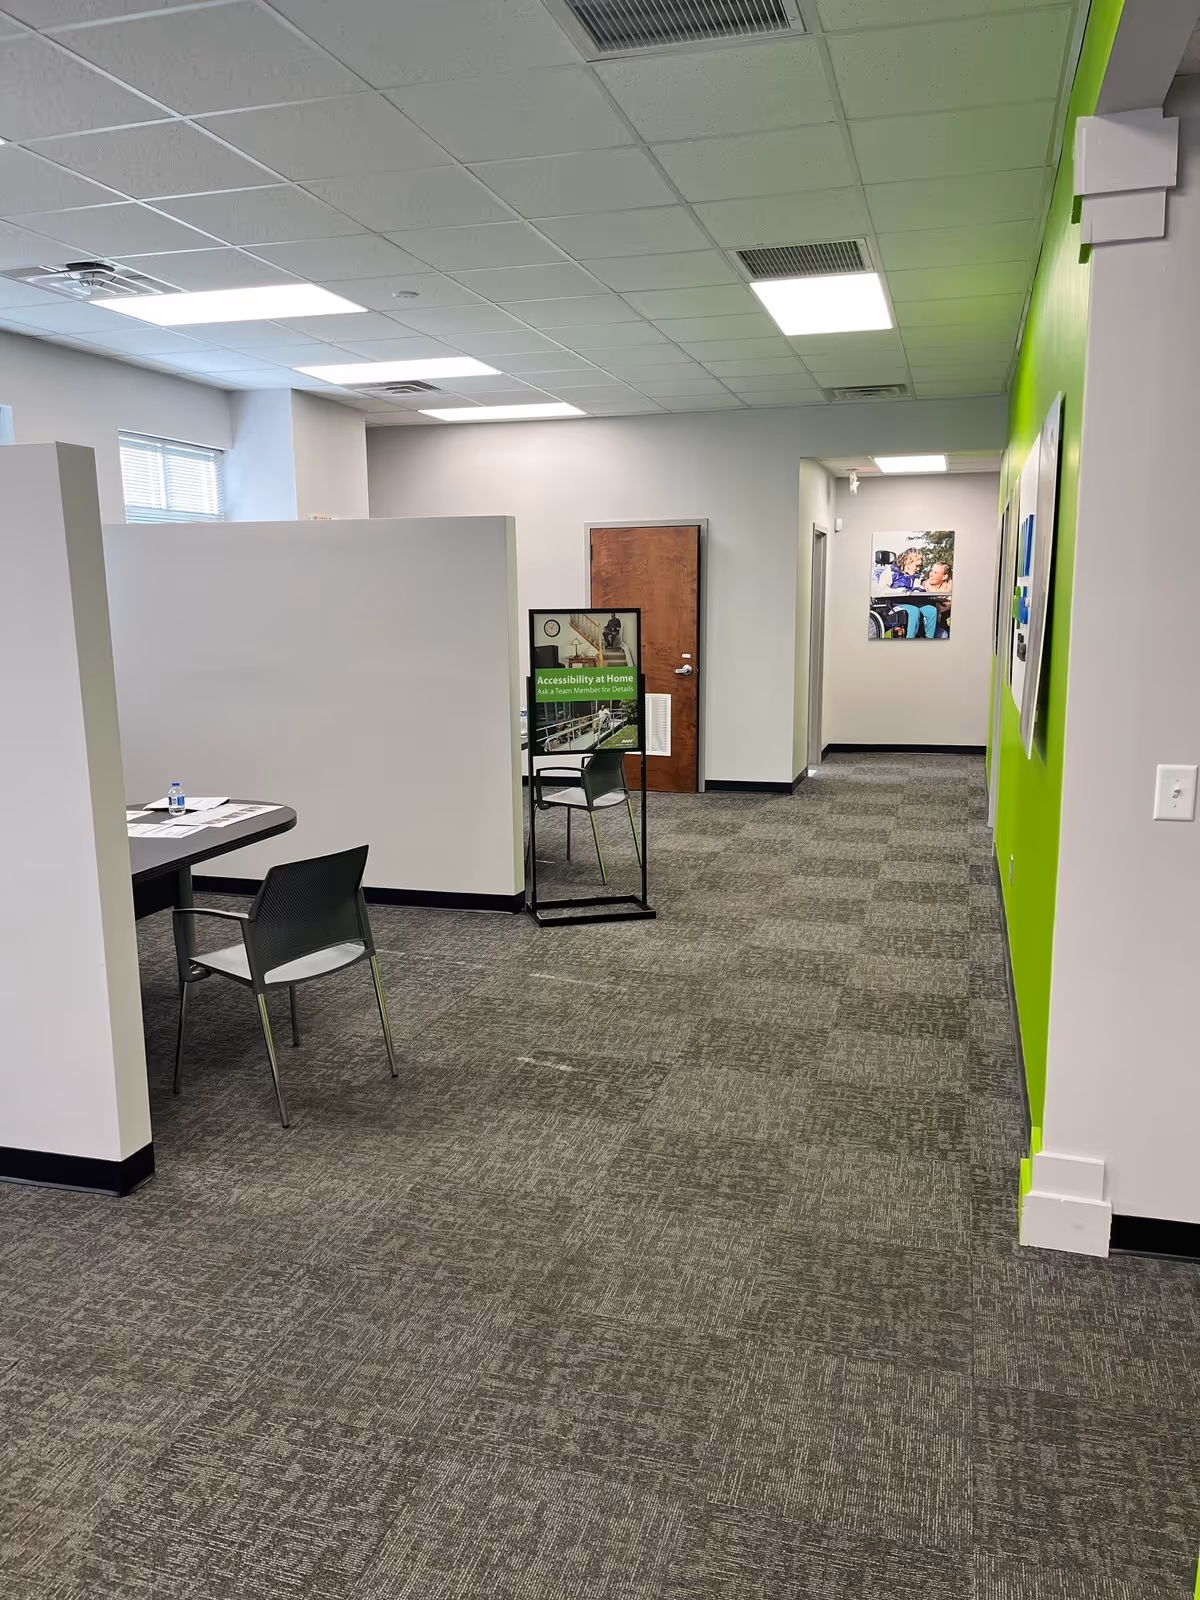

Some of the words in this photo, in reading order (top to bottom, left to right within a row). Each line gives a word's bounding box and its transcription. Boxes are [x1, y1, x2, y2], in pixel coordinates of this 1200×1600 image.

[537, 675, 594, 686] Accessibility
[595, 675, 605, 683] at
[606, 674, 634, 683] Home
[612, 685, 634, 693] Details
